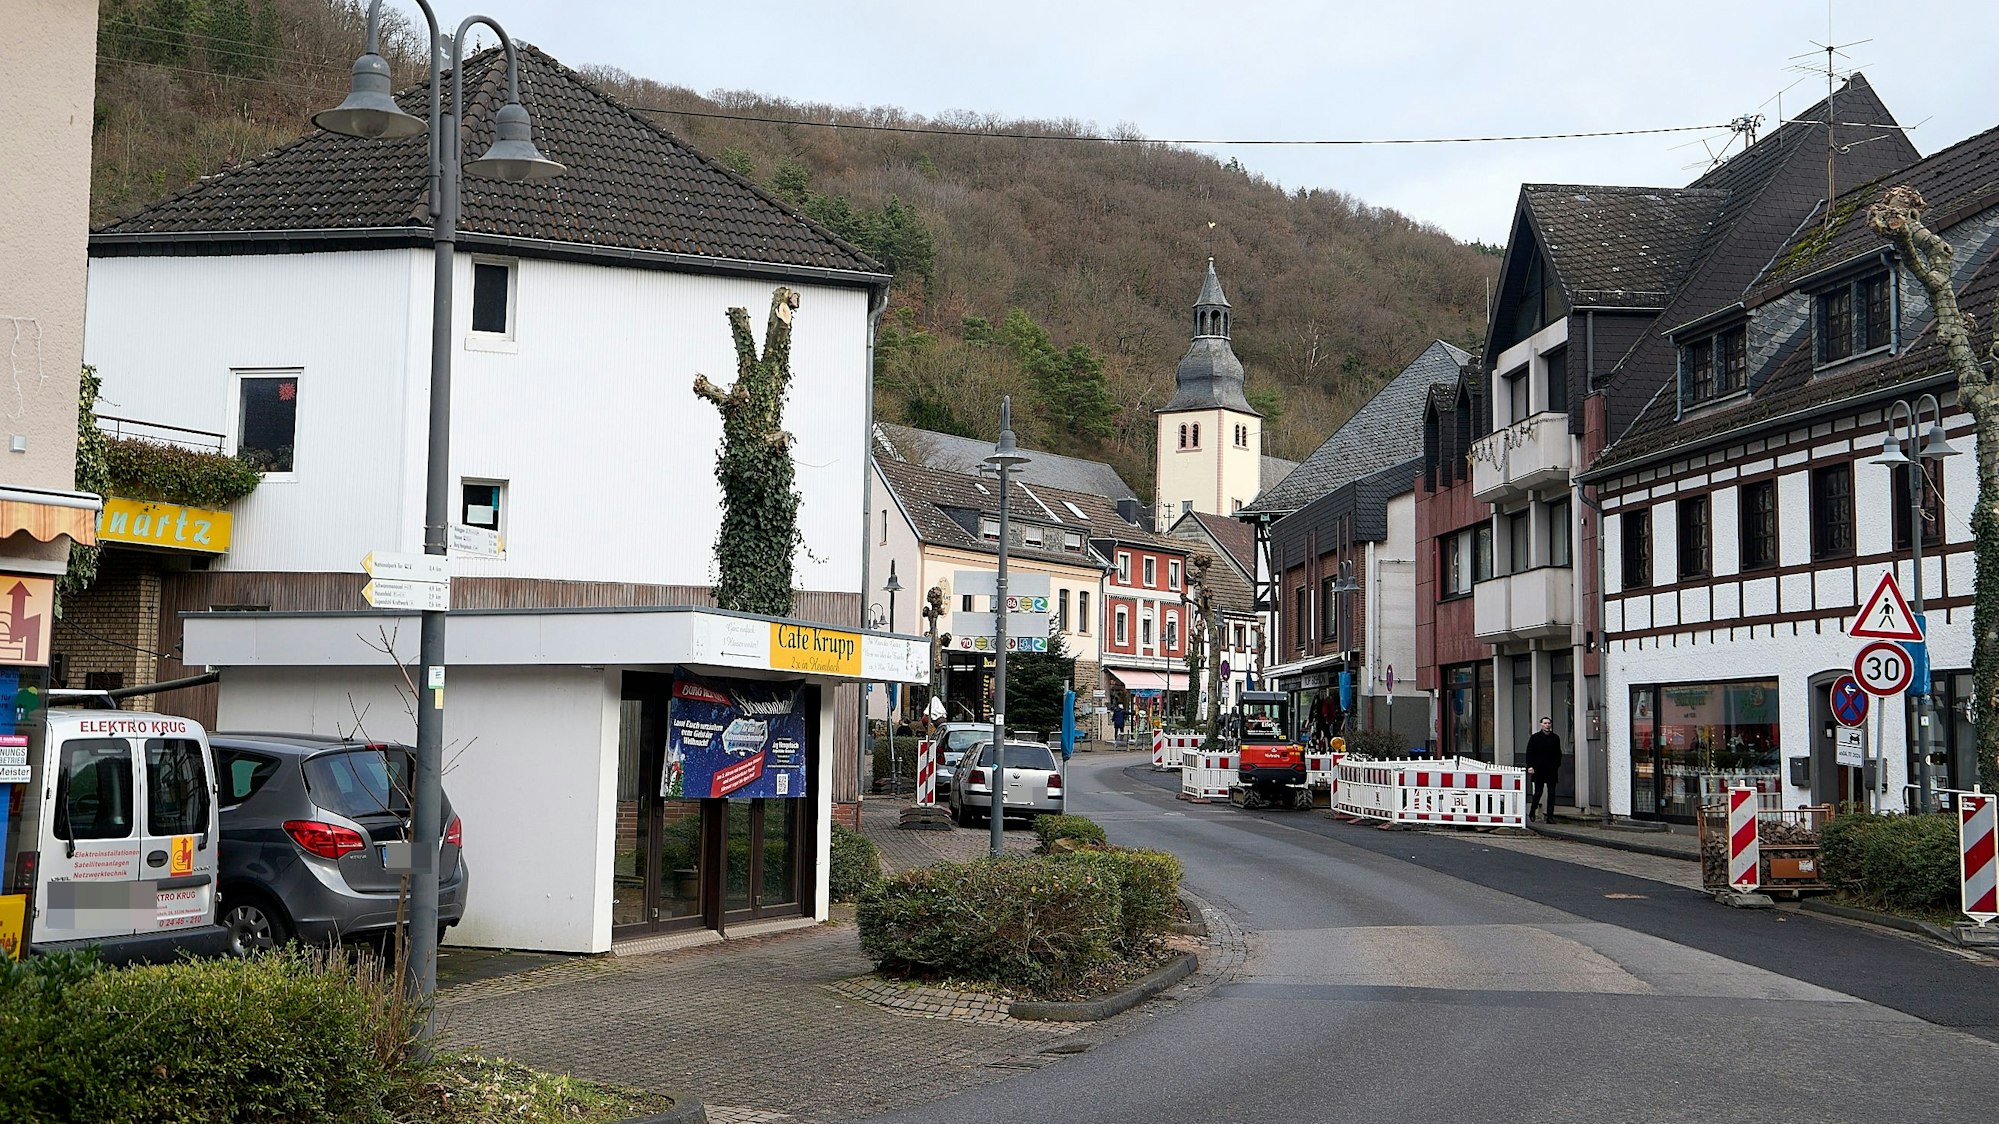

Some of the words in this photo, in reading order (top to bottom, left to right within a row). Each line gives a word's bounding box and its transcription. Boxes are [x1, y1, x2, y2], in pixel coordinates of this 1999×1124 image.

[1006, 599, 1017, 608] 86
[778, 623, 809, 650] Café
[812, 628, 854, 661] Krupp
[962, 639, 972, 648] 70
[1866, 657, 1899, 681] 30
[80, 721, 147, 733] ELEKTRO
[151, 721, 186, 733] KRUG
[74, 849, 140, 858] Elektroinstallationen
[73, 860, 130, 869] Satellitenanlagen
[73, 869, 128, 879] Netzwerktechnik
[176, 891, 196, 900] KRUG
